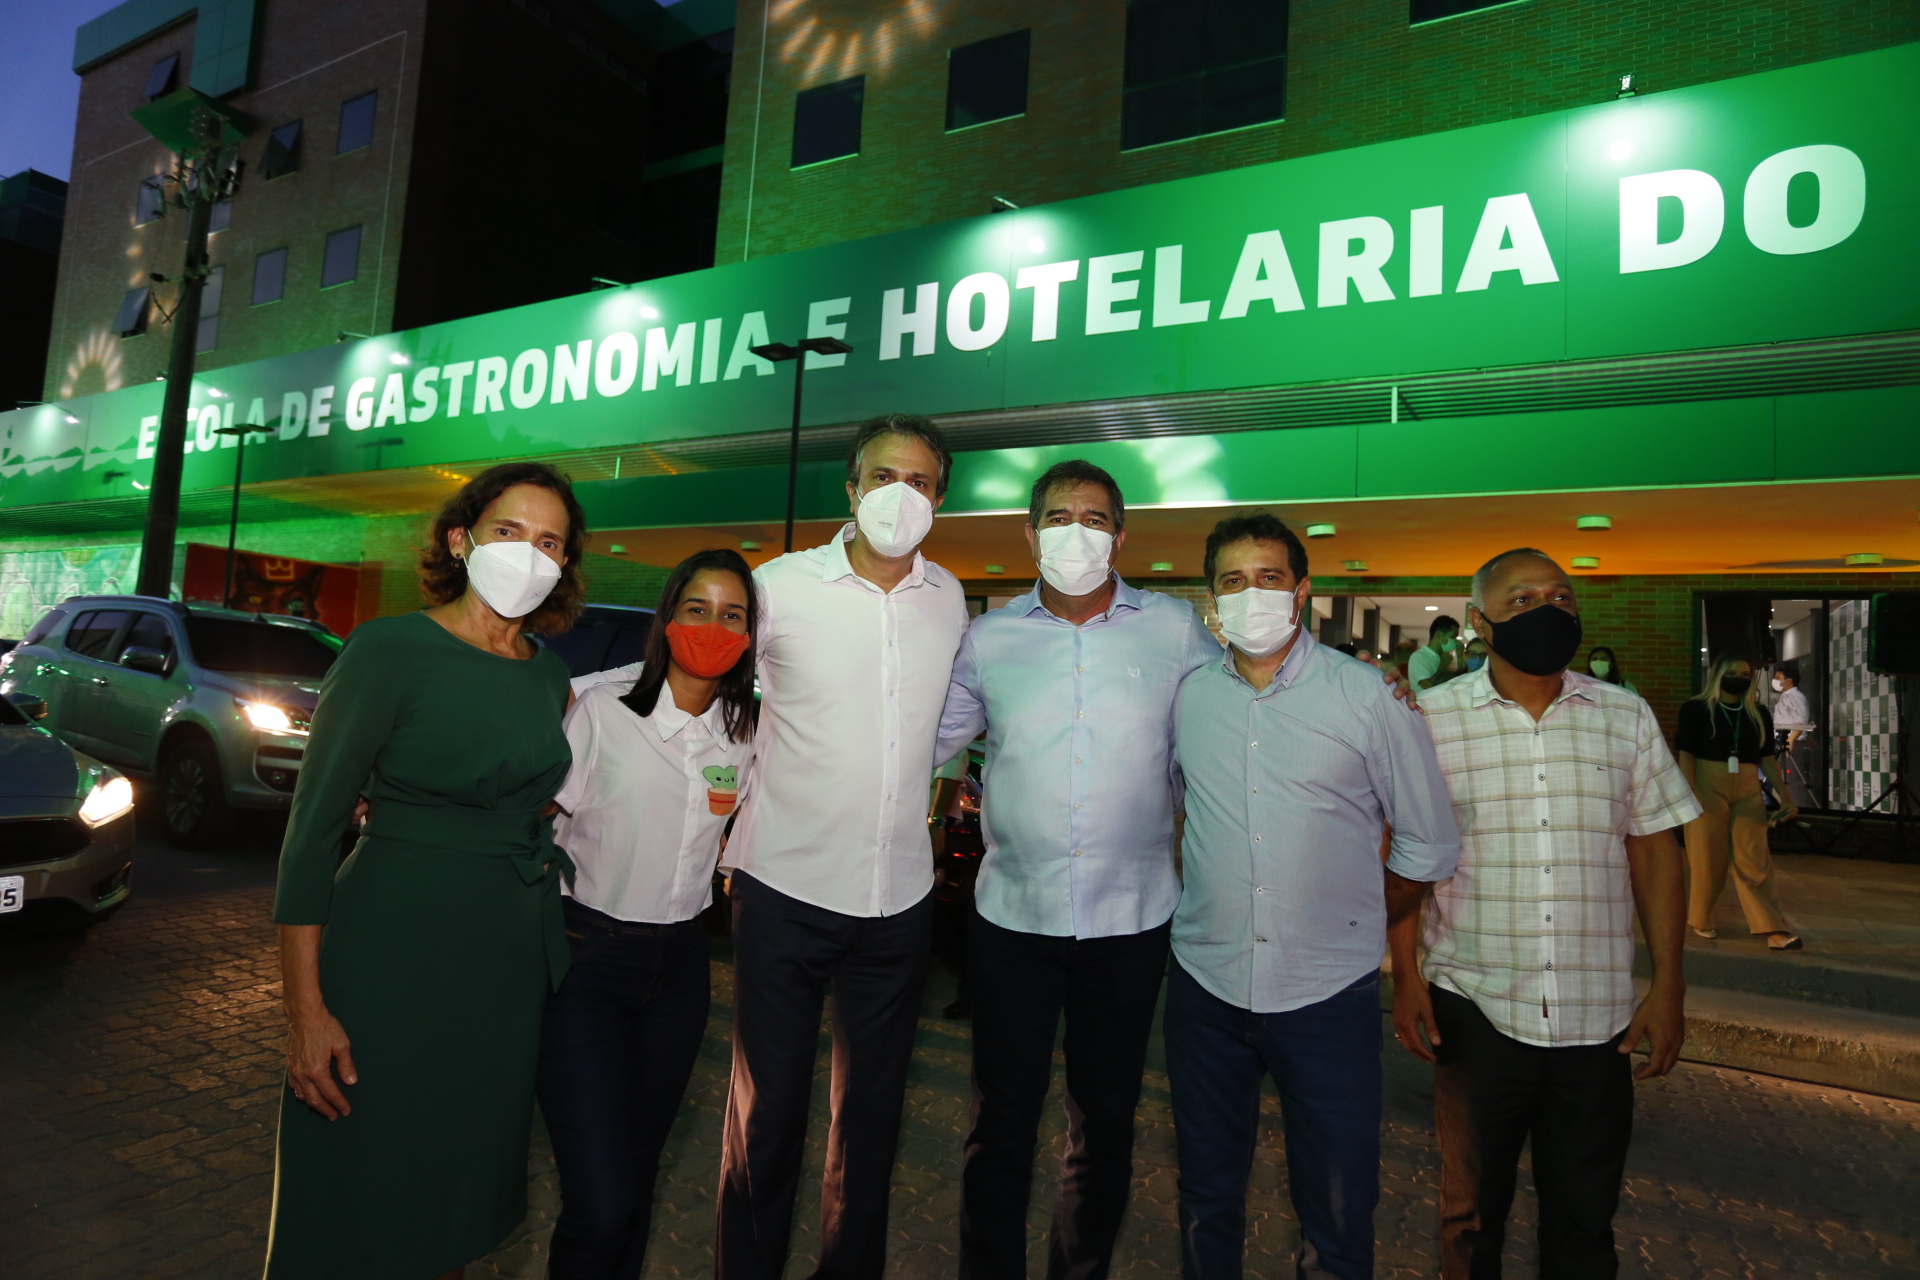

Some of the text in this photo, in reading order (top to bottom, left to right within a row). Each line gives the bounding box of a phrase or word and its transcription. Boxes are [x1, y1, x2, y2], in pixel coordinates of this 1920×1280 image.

[136, 144, 1866, 460] ECOLA DE GASTRONOMIA E HOTELARIA DO
[0, 888, 17, 907] 5
